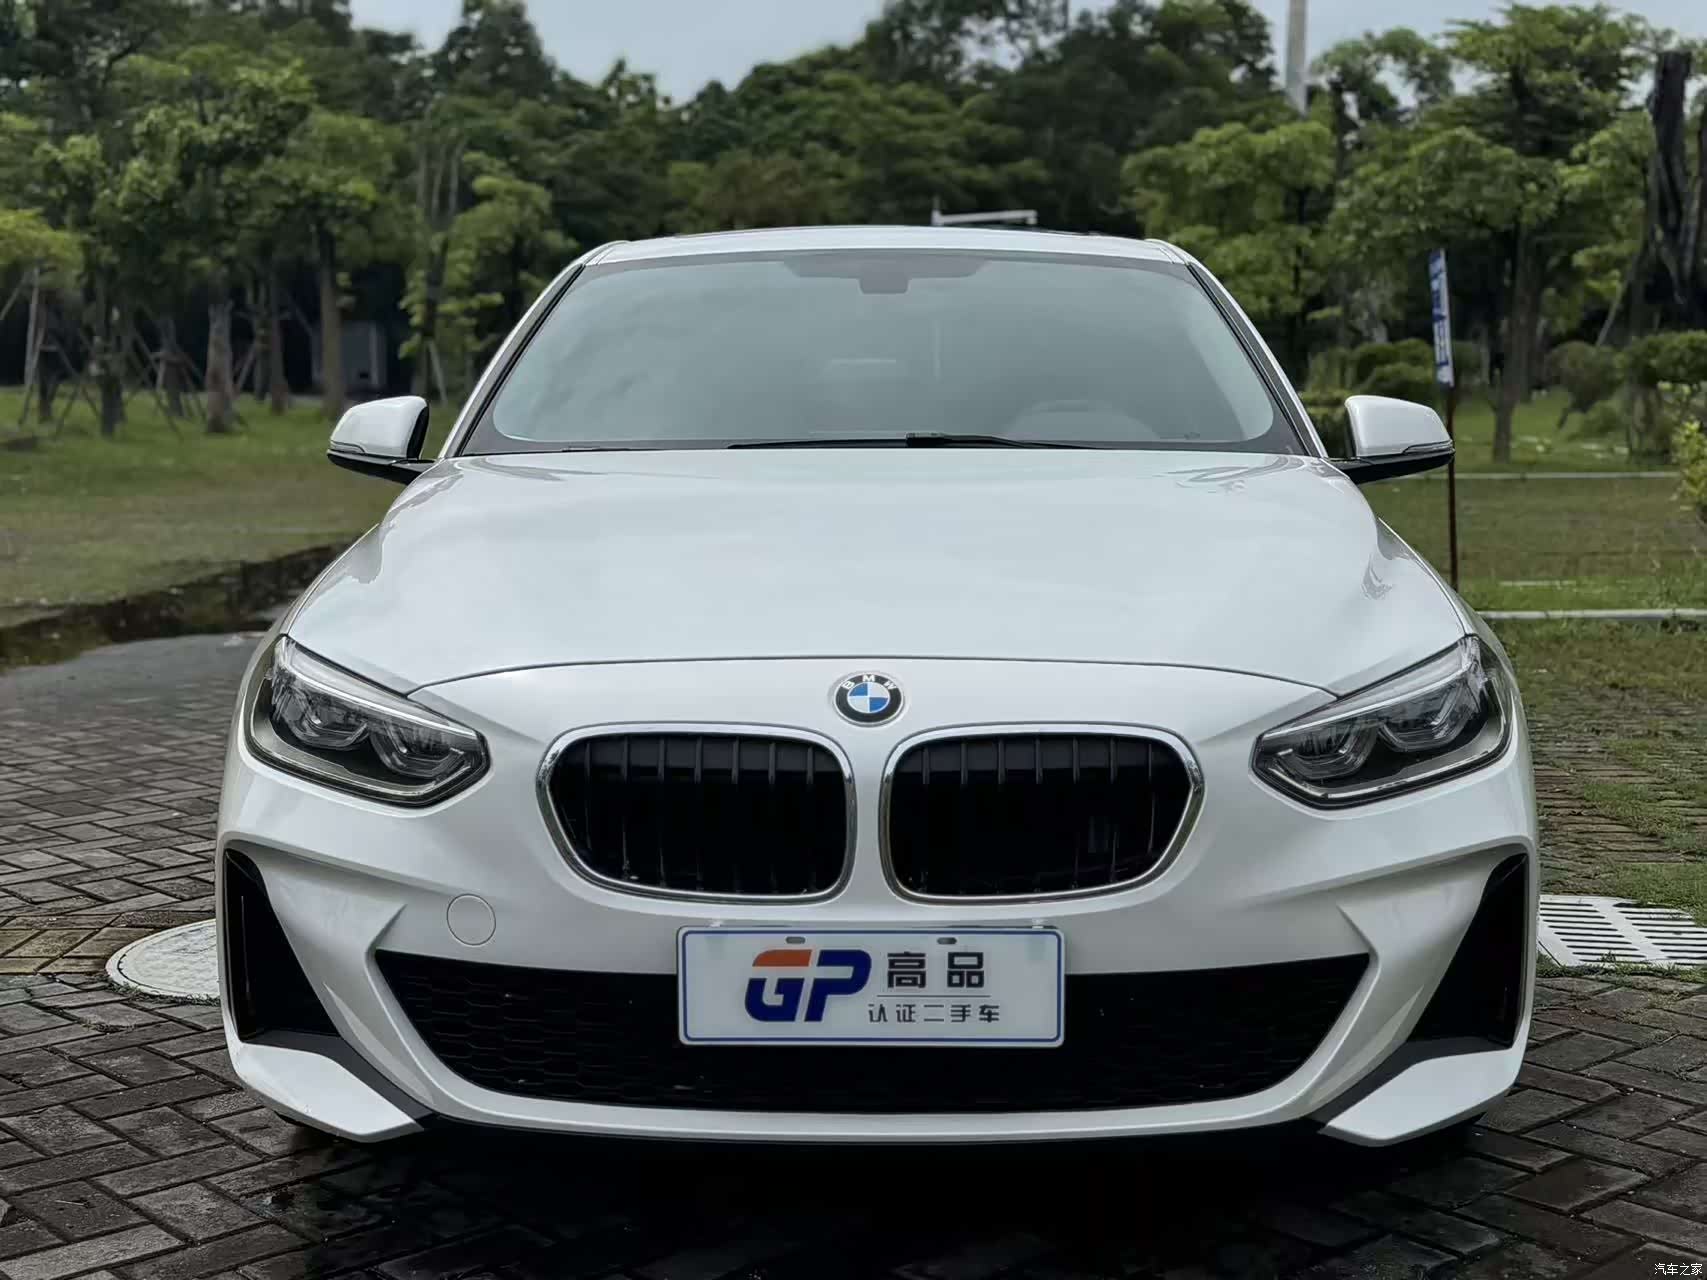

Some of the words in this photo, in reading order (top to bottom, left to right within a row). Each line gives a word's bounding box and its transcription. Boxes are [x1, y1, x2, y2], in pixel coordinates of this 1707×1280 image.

[841, 674, 897, 690] BMW
[887, 951, 985, 988] 高品
[744, 949, 872, 1022] GP
[868, 1003, 1000, 1023] 认证二手车
